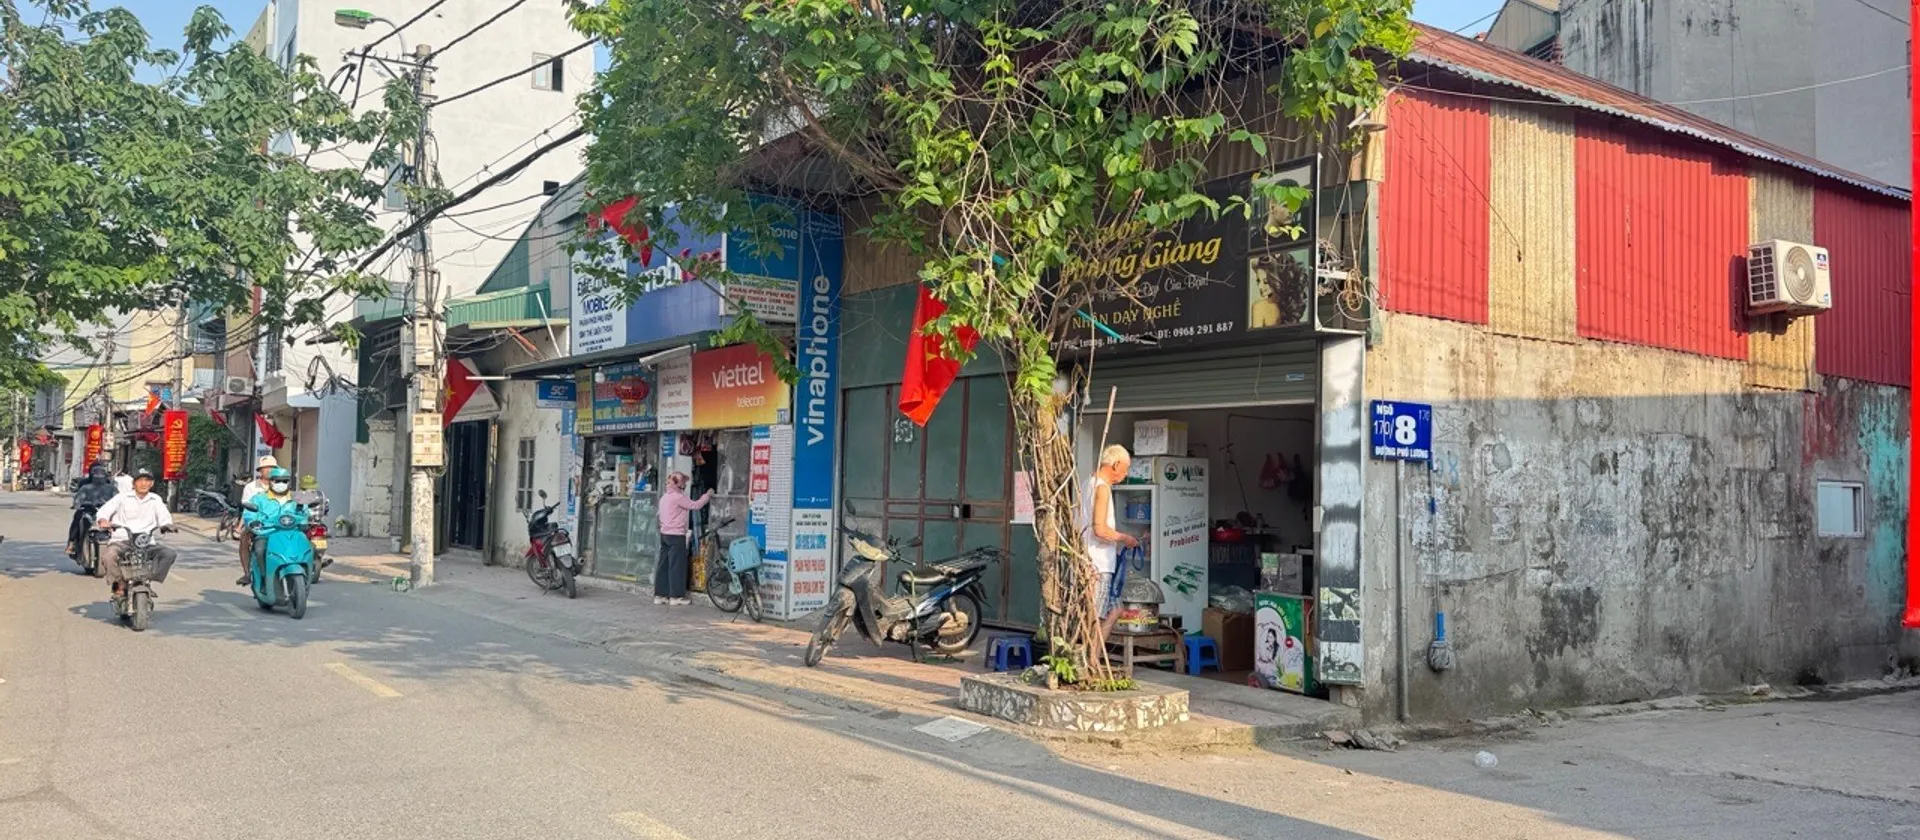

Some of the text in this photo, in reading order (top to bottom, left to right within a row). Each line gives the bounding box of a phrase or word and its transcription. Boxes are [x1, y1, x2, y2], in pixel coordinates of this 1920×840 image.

[1144, 236, 1223, 268] Giang
[1173, 326, 1195, 338] 0968
[1197, 325, 1213, 335] 291
[1216, 321, 1234, 333] 887
[803, 274, 831, 446] vinaphone
[712, 361, 765, 389] viettel
[737, 395, 766, 409] telecom
[1376, 404, 1394, 416] NGÕ
[1169, 535, 1200, 548] Probiotic
